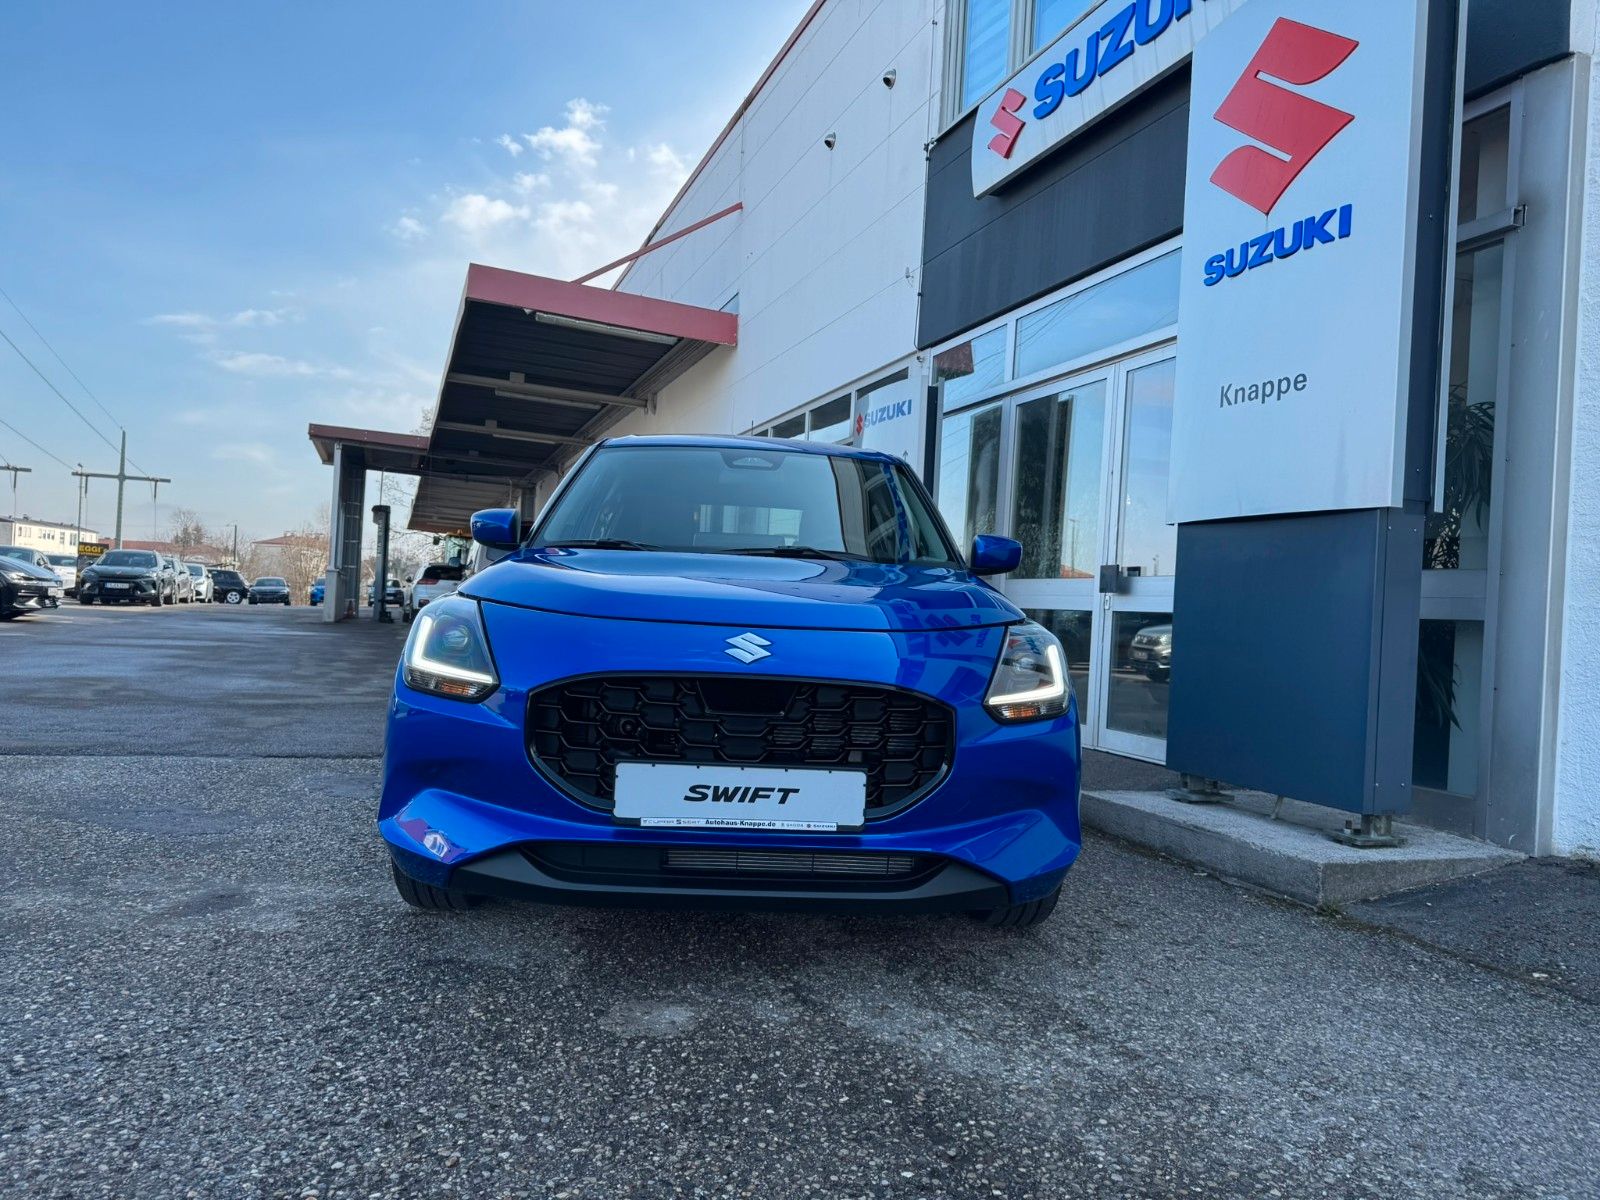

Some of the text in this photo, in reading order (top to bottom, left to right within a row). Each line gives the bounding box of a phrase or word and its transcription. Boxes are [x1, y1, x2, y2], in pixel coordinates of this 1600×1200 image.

[1033, 0, 1192, 120] SUZU
[1203, 204, 1353, 286] SUZUKI
[1220, 373, 1307, 408] Knappe
[864, 399, 912, 428] SUZUKI
[683, 784, 800, 804] SWIFT
